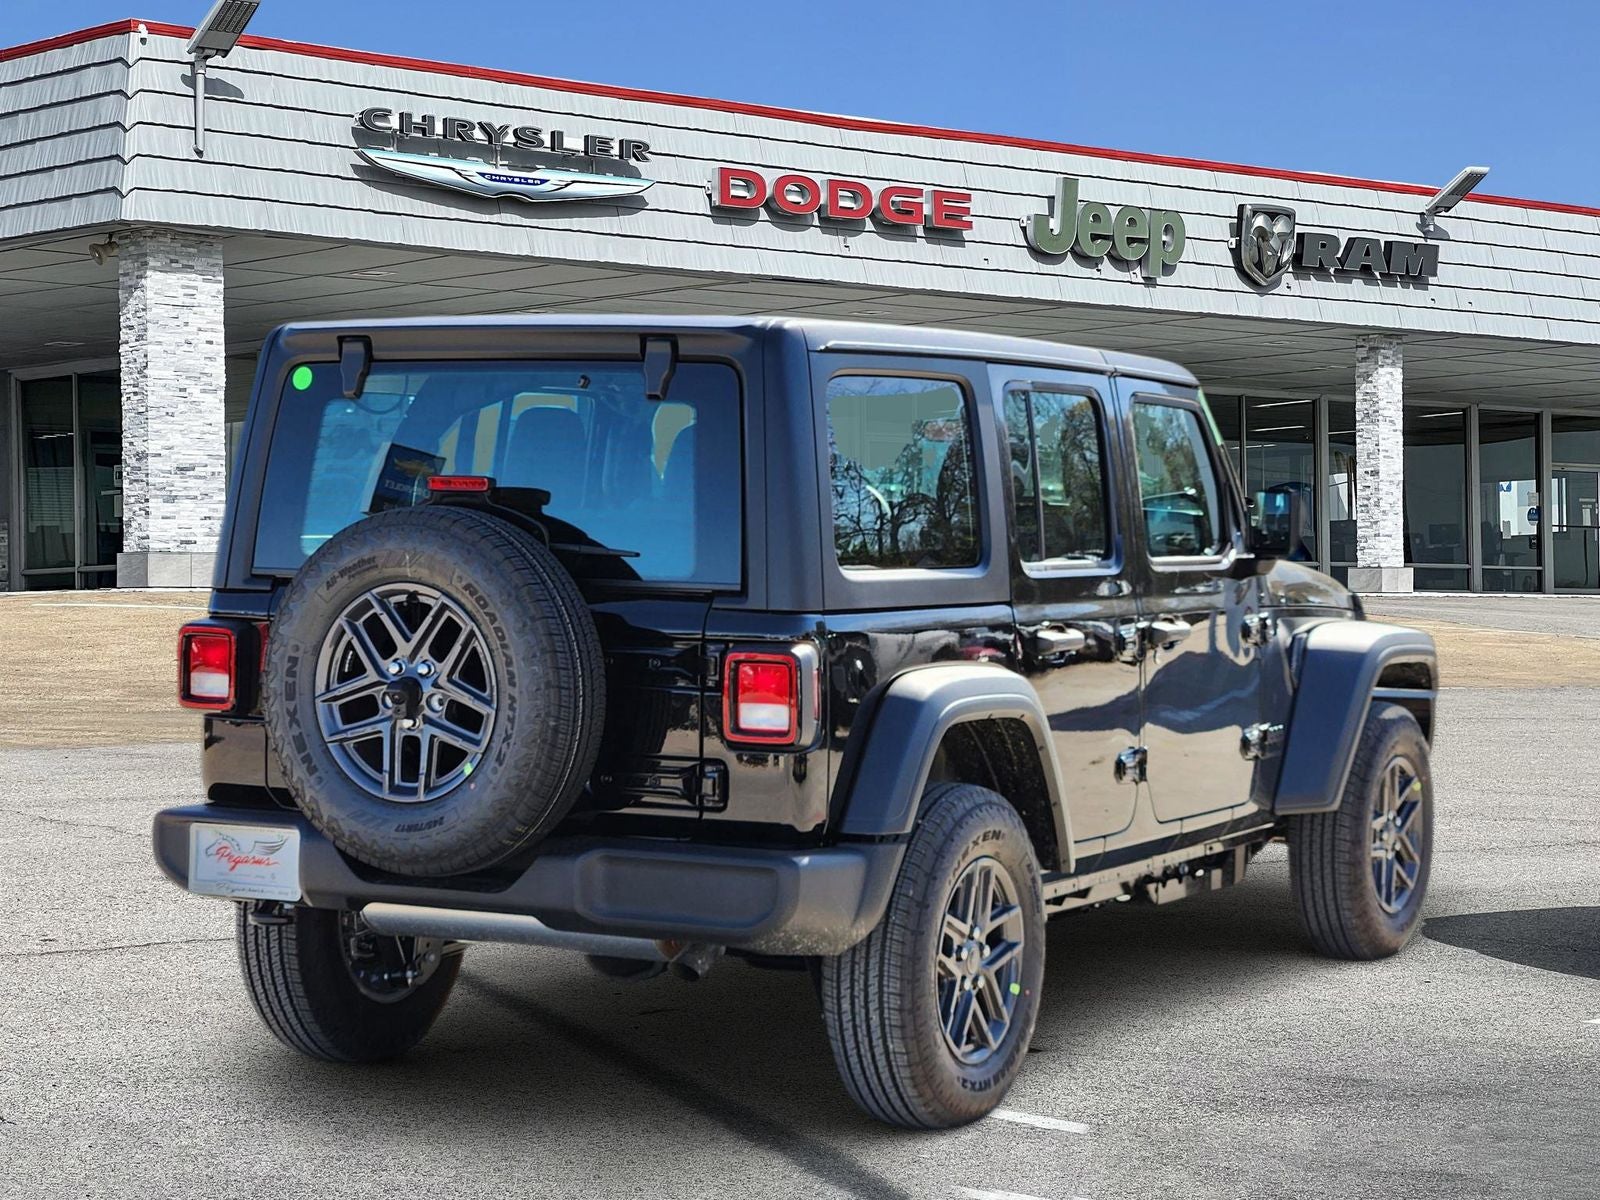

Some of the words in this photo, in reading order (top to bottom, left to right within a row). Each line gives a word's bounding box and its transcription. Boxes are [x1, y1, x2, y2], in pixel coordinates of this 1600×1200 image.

[359, 106, 651, 163] CHRYSLER
[484, 174, 541, 185] CHRYSLER
[712, 166, 974, 231] DODGE
[1026, 176, 1187, 279] Jeep
[1297, 231, 1440, 278] RAM
[462, 582, 517, 689] ROADIAN
[495, 692, 518, 768] HTX2
[284, 655, 320, 778] NEXEN
[215, 845, 280, 872] Pegasus
